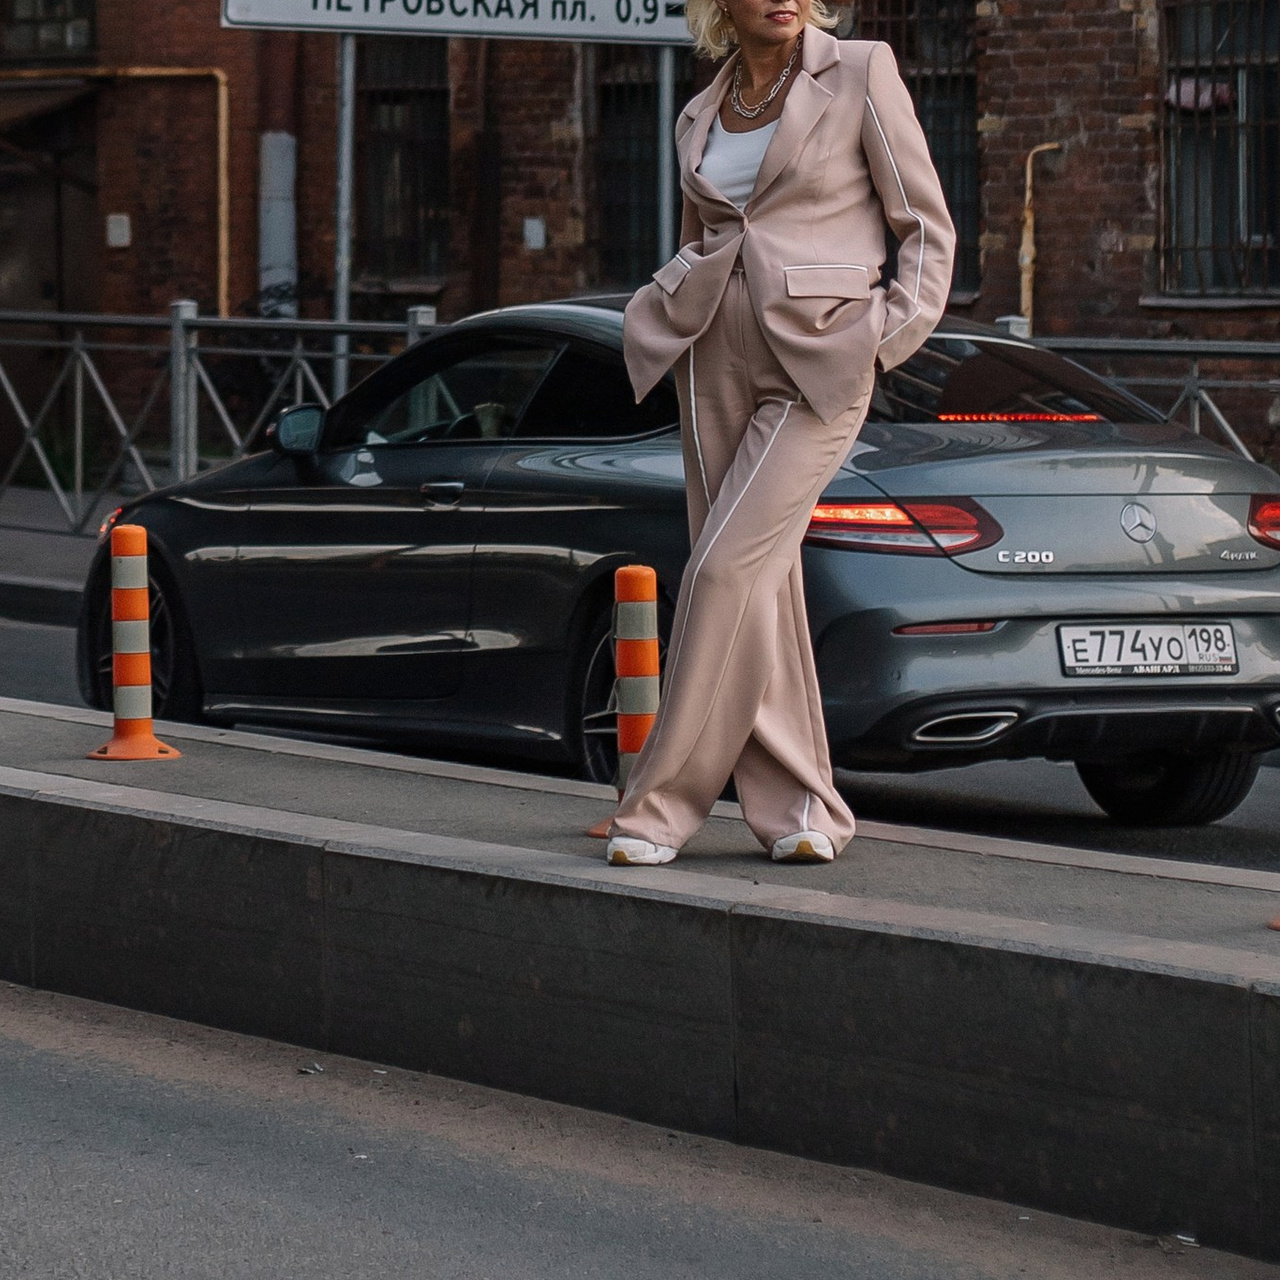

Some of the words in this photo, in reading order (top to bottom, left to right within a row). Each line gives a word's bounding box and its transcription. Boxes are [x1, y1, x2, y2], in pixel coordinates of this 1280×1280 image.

[997, 550, 1011, 563] C
[1014, 550, 1054, 563] 200
[1187, 627, 1227, 653] 198
[1198, 652, 1219, 662] RUS
